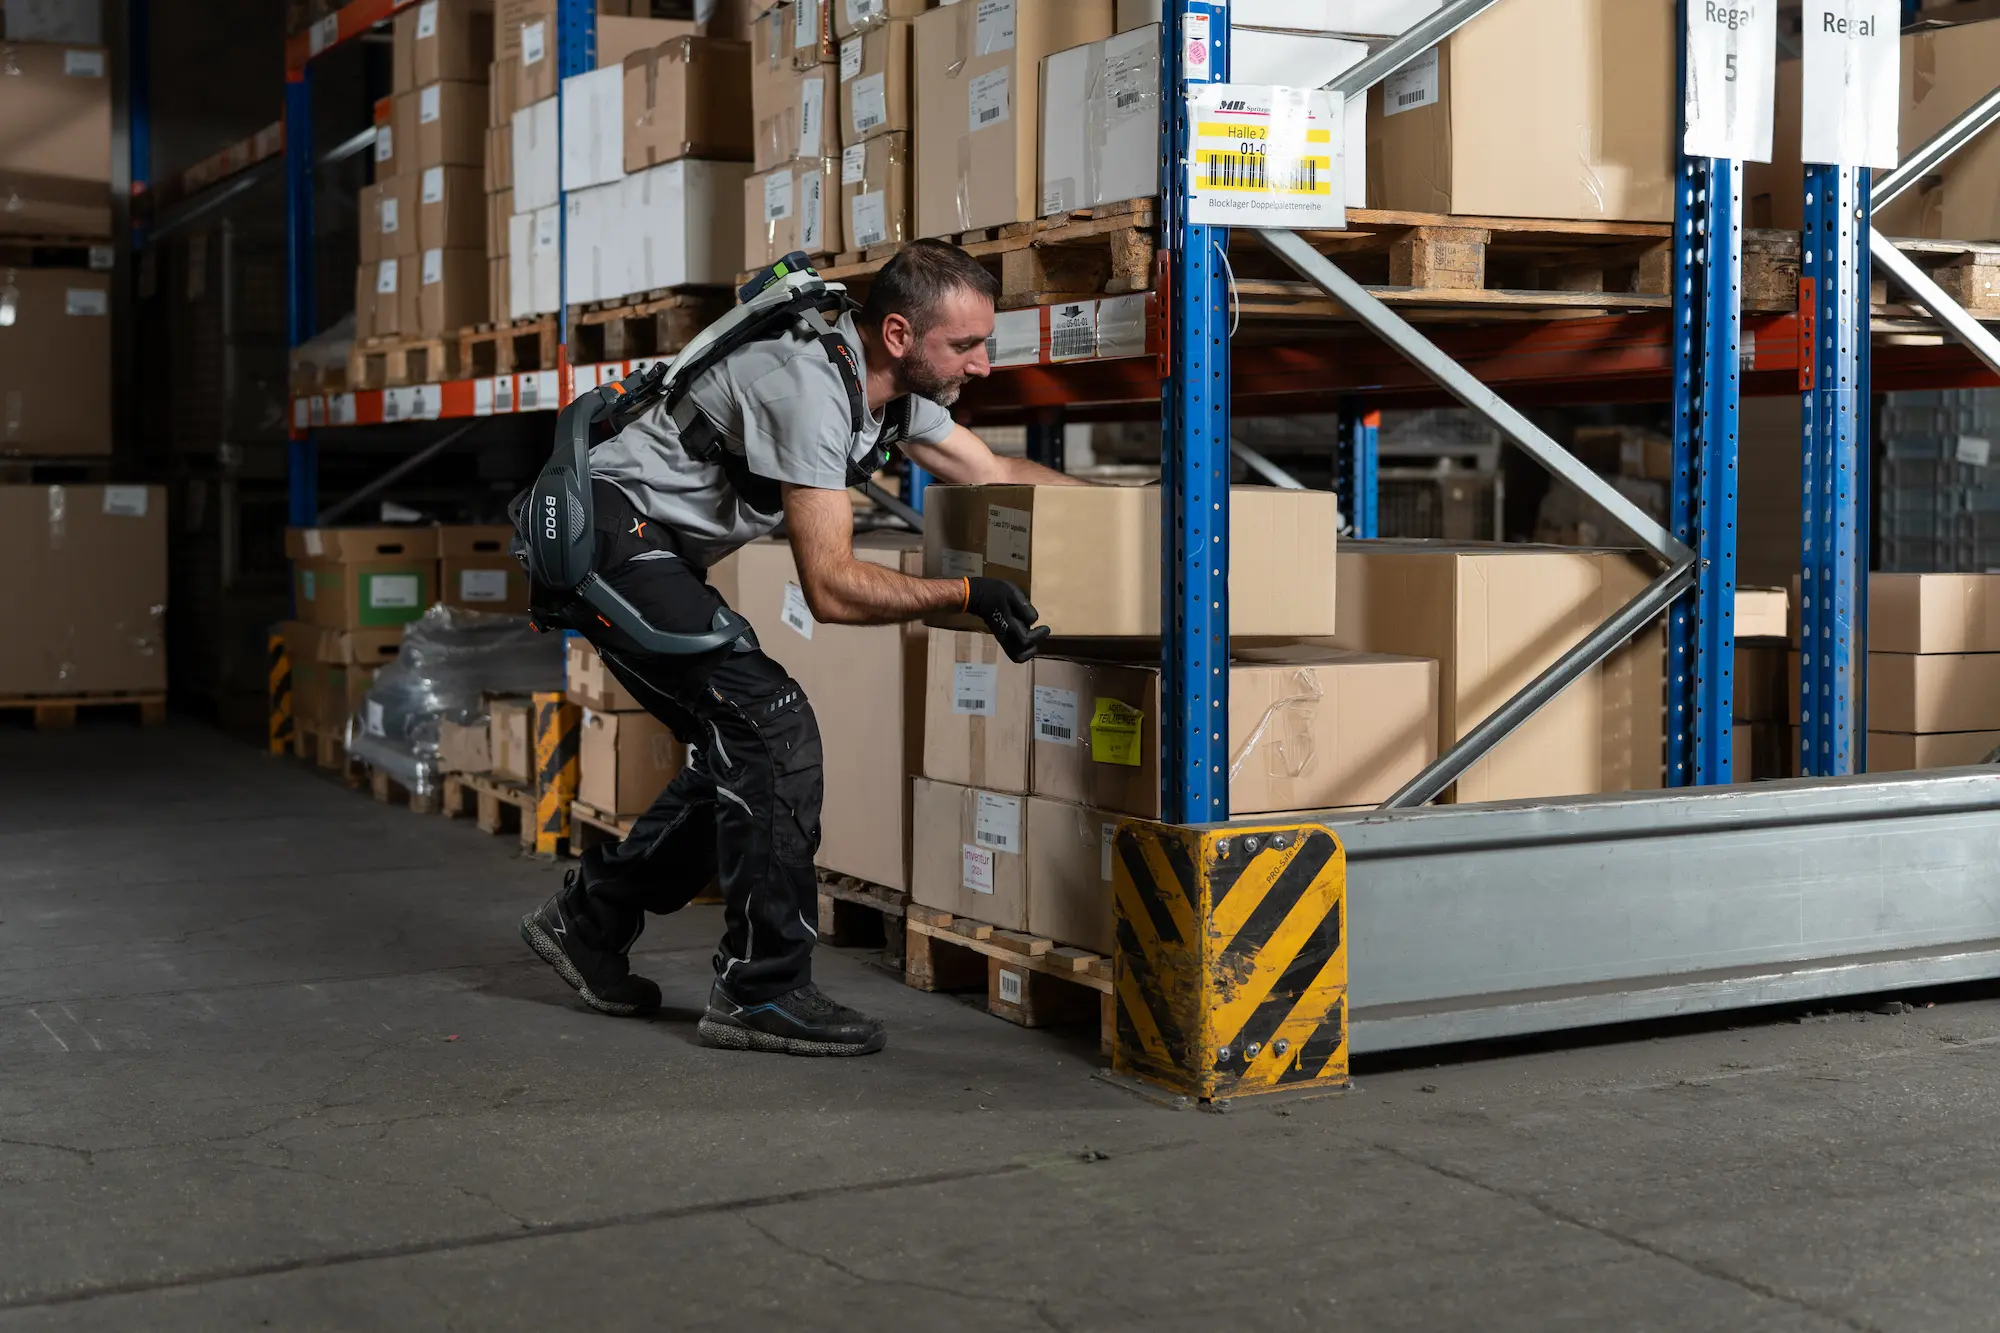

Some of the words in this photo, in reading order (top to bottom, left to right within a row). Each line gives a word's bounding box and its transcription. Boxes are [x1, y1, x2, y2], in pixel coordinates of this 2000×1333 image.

[1705, 1, 1755, 30] Regal
[1823, 12, 1875, 39] Regal
[1725, 54, 1737, 82] 5
[1228, 126, 1257, 139] Halle
[1259, 128, 1266, 140] 2
[1208, 199, 1249, 209] Blocklager
[1251, 200, 1322, 211] Doppelpalettenreihe
[545, 495, 557, 539] B900
[964, 848, 990, 865] Inventur
[1266, 850, 1294, 884] PRO-Safe
